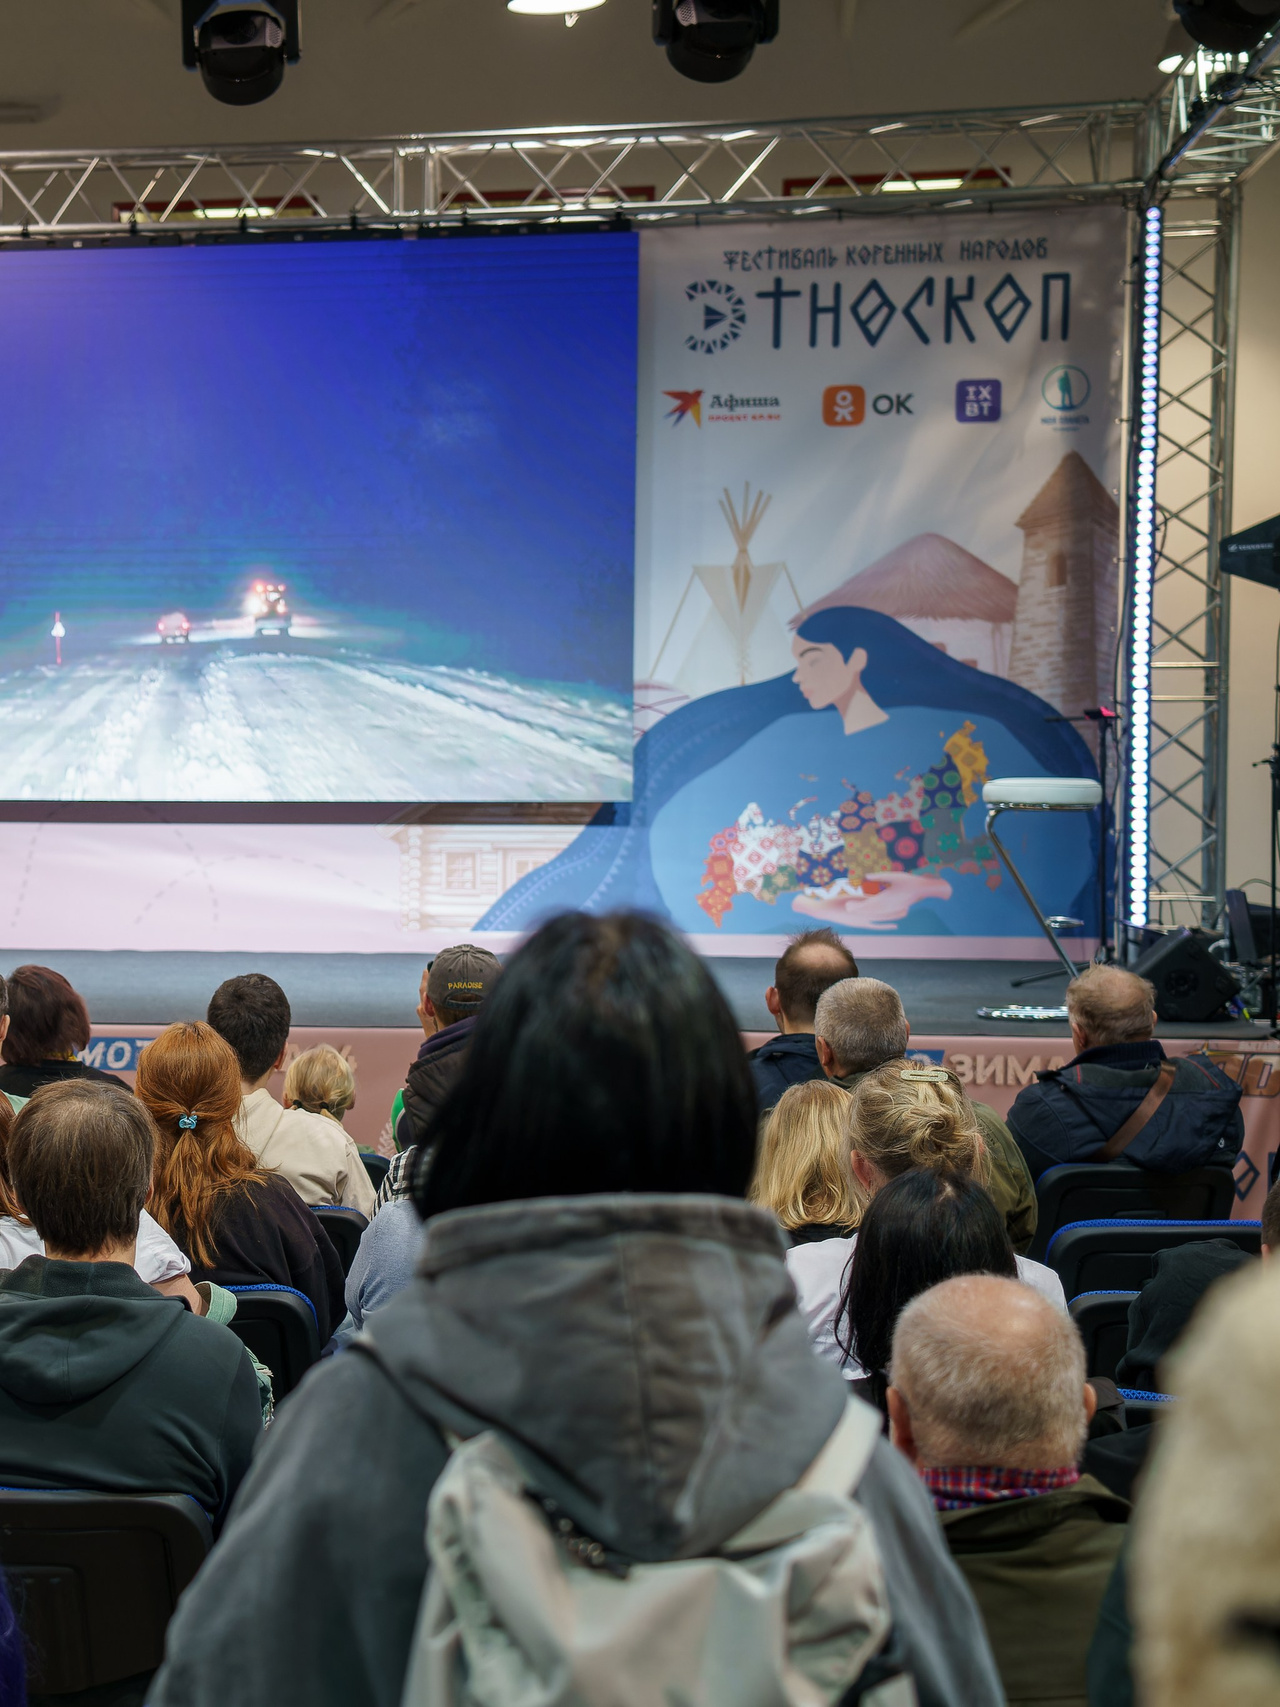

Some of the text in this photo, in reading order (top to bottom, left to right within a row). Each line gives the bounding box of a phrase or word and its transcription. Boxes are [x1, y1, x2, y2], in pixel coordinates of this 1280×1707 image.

[723, 237, 1048, 271] ФЕСТИВАЛЬ КОРЕННЫХ НАРОДОВ
[709, 393, 780, 412] Афиша
[447, 981, 483, 990] PARADISE
